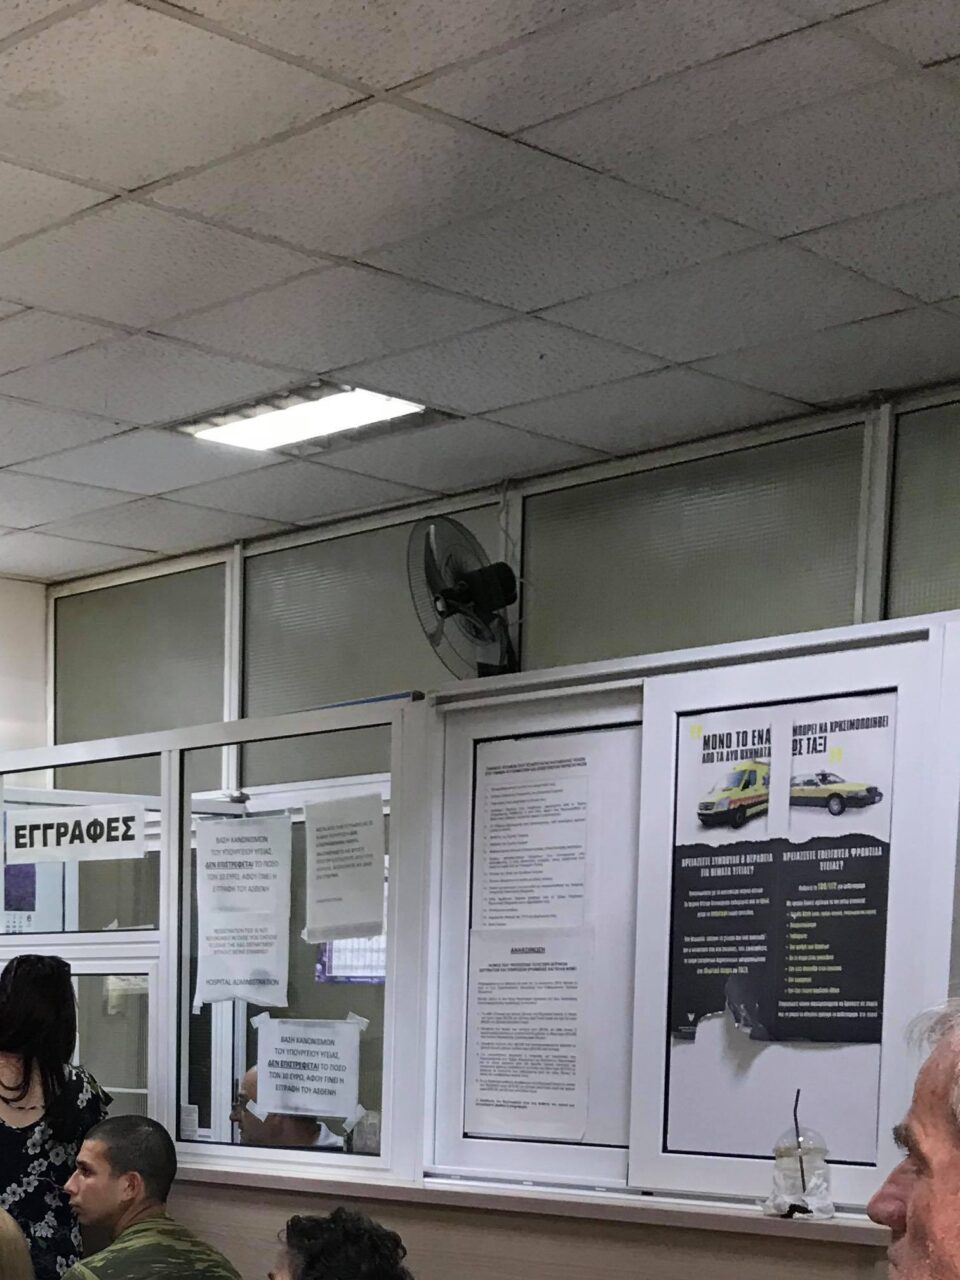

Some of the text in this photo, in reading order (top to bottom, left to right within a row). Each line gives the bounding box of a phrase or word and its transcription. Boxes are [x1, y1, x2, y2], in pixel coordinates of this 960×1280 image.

[703, 728, 771, 751] ΜΟΝΟ ΤΟ ΕΝΑ
[792, 723, 817, 737] ΜΠΟΡΕΙ
[819, 722, 827, 734] ΝΑ
[702, 752, 715, 764] ΑΠΟ
[716, 751, 724, 763] ΤΑ
[740, 746, 771, 761] ΟΧΗΜΑΤΑ
[792, 735, 827, 757] ΩΣ ΤΑΞΙ
[14, 815, 136, 849] ΕΓΓΡΑΦΕΣ
